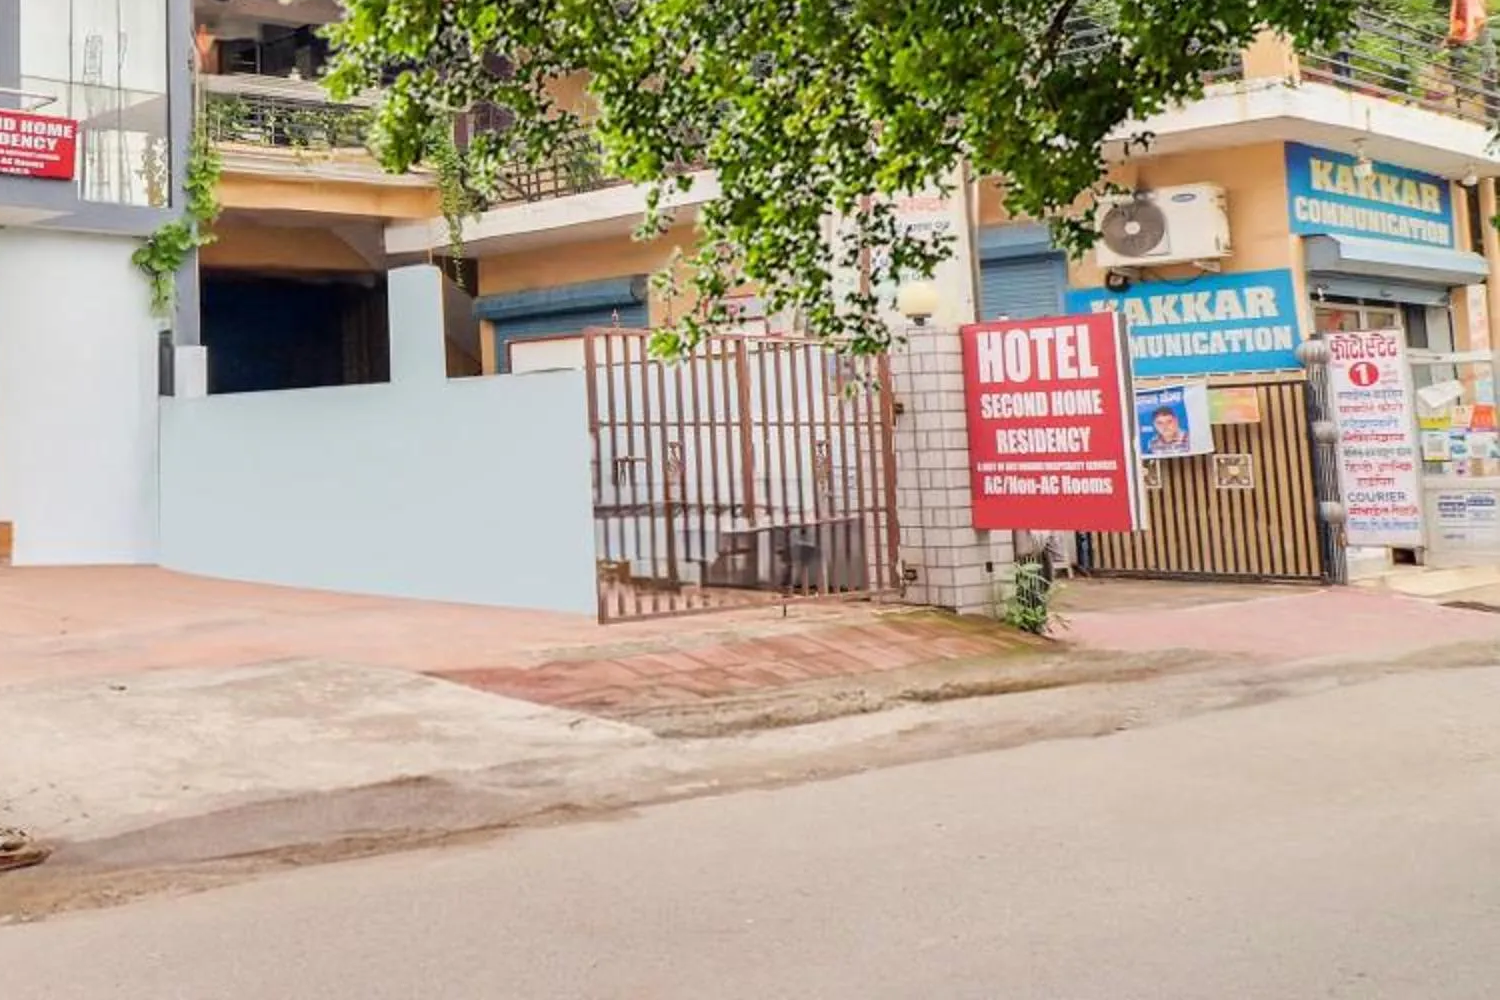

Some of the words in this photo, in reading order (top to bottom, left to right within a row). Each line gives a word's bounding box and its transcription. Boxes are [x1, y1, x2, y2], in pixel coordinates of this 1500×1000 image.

[19, 119, 73, 138] HOME
[1309, 157, 1442, 214] KAKKAR
[1294, 196, 1450, 245] COMMUNICATION
[976, 324, 1099, 384] HOTEL
[980, 391, 1048, 419] SECOND
[1051, 389, 1104, 416] HOME
[995, 426, 1092, 455] RESIDENCY
[1061, 475, 1113, 495] Rooms
[1347, 491, 1405, 503] COURIER
